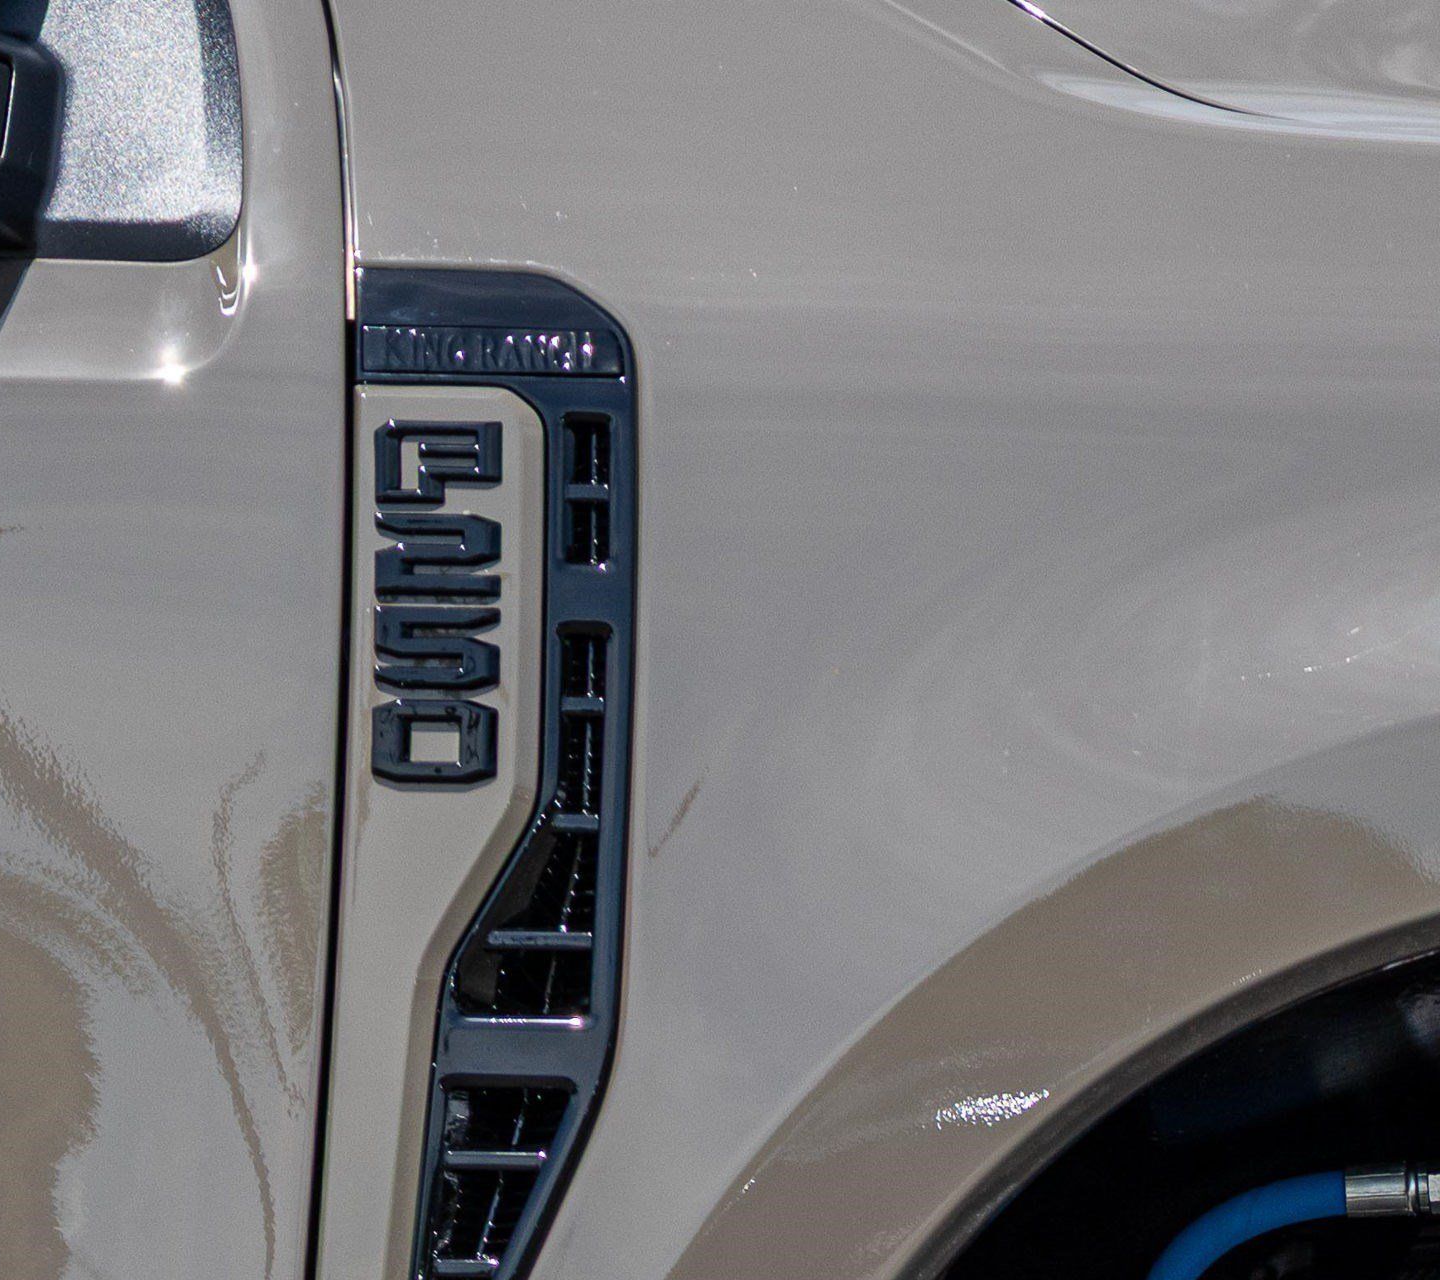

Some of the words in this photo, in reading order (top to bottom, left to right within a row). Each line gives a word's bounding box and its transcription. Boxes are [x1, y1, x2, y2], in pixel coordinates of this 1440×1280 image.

[386, 334, 472, 370] KING
[477, 331, 595, 369] RANCH
[372, 420, 502, 788] F250
